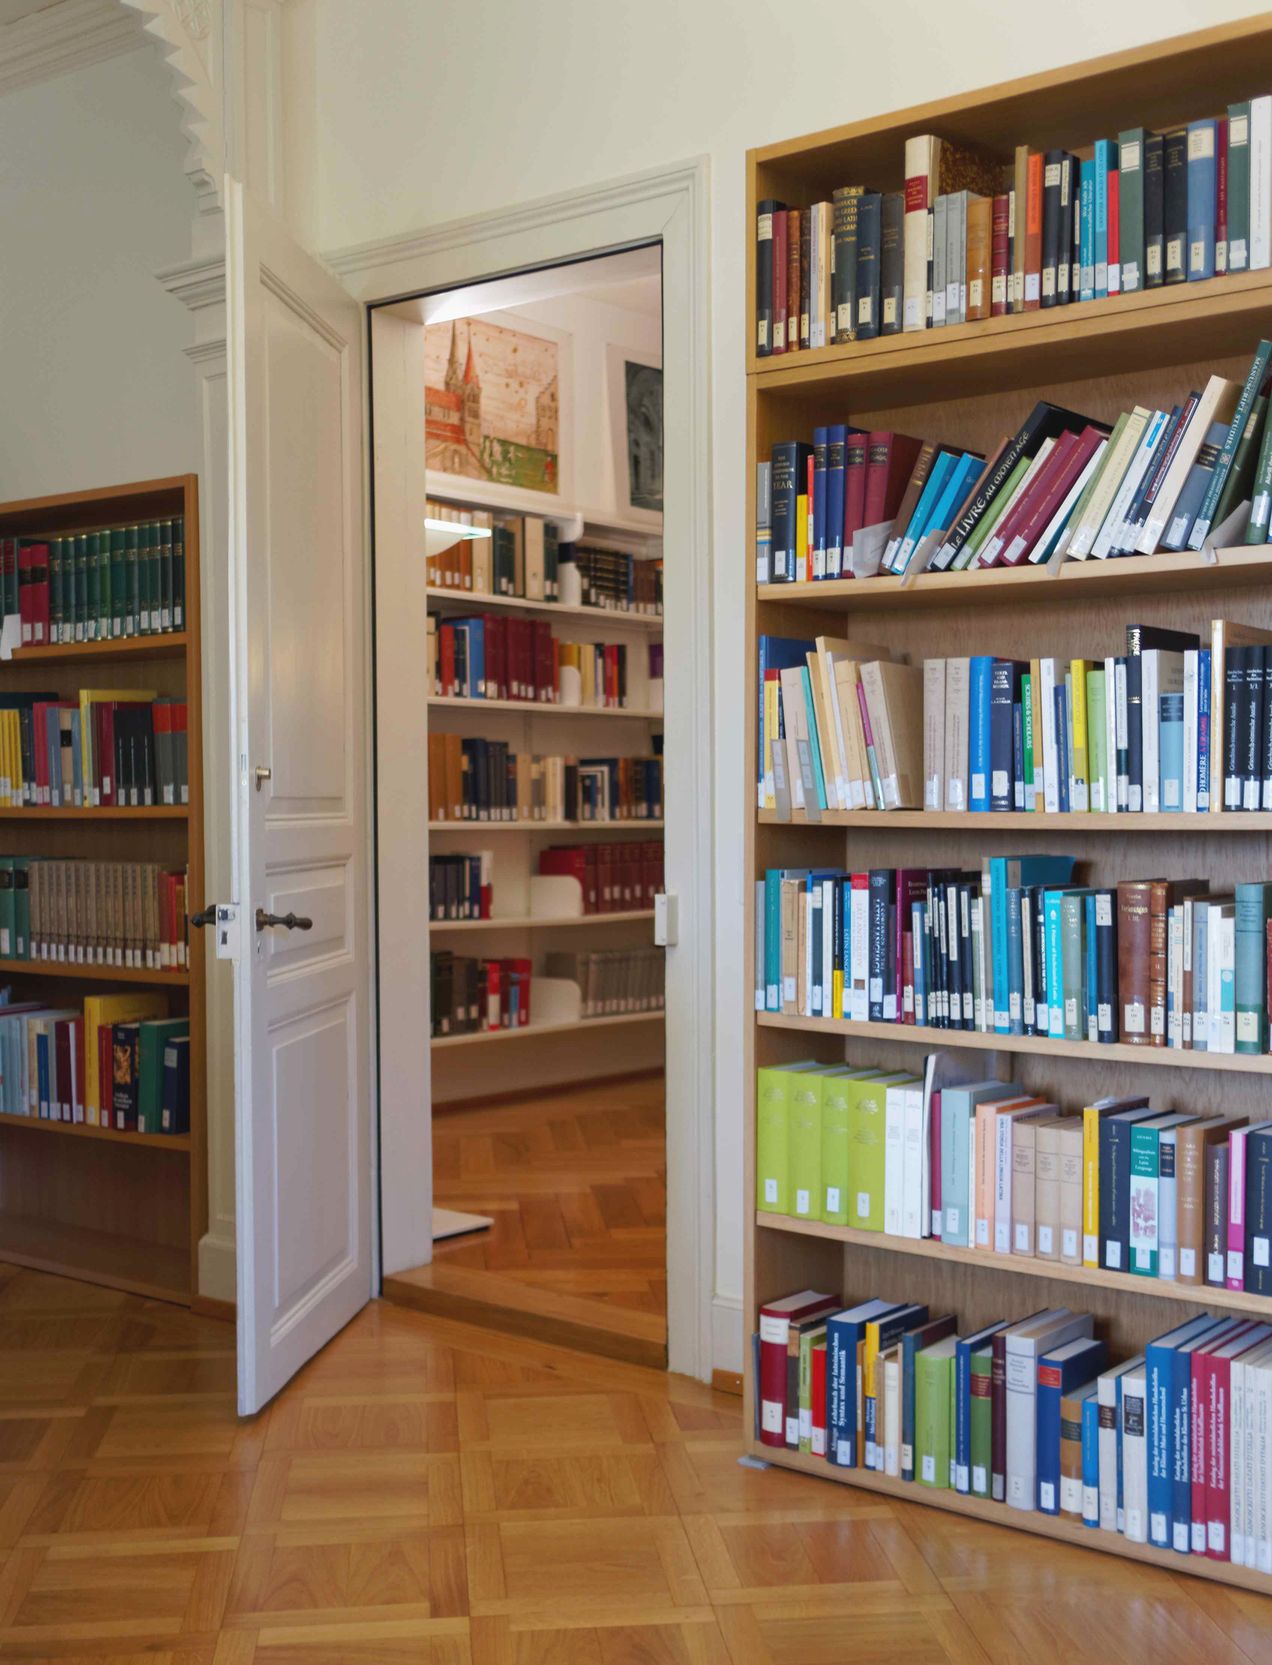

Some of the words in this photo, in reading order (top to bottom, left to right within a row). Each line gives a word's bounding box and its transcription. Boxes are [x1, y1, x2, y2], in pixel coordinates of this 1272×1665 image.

[1238, 357, 1261, 412] MANUSCRIPT
[1224, 413, 1241, 450] STUDIES
[772, 480, 793, 490] YEAR
[956, 497, 986, 536] LIVRE
[985, 484, 996, 500] AU
[994, 451, 1017, 485] MOYEN
[838, 1401, 847, 1426] Syntax
